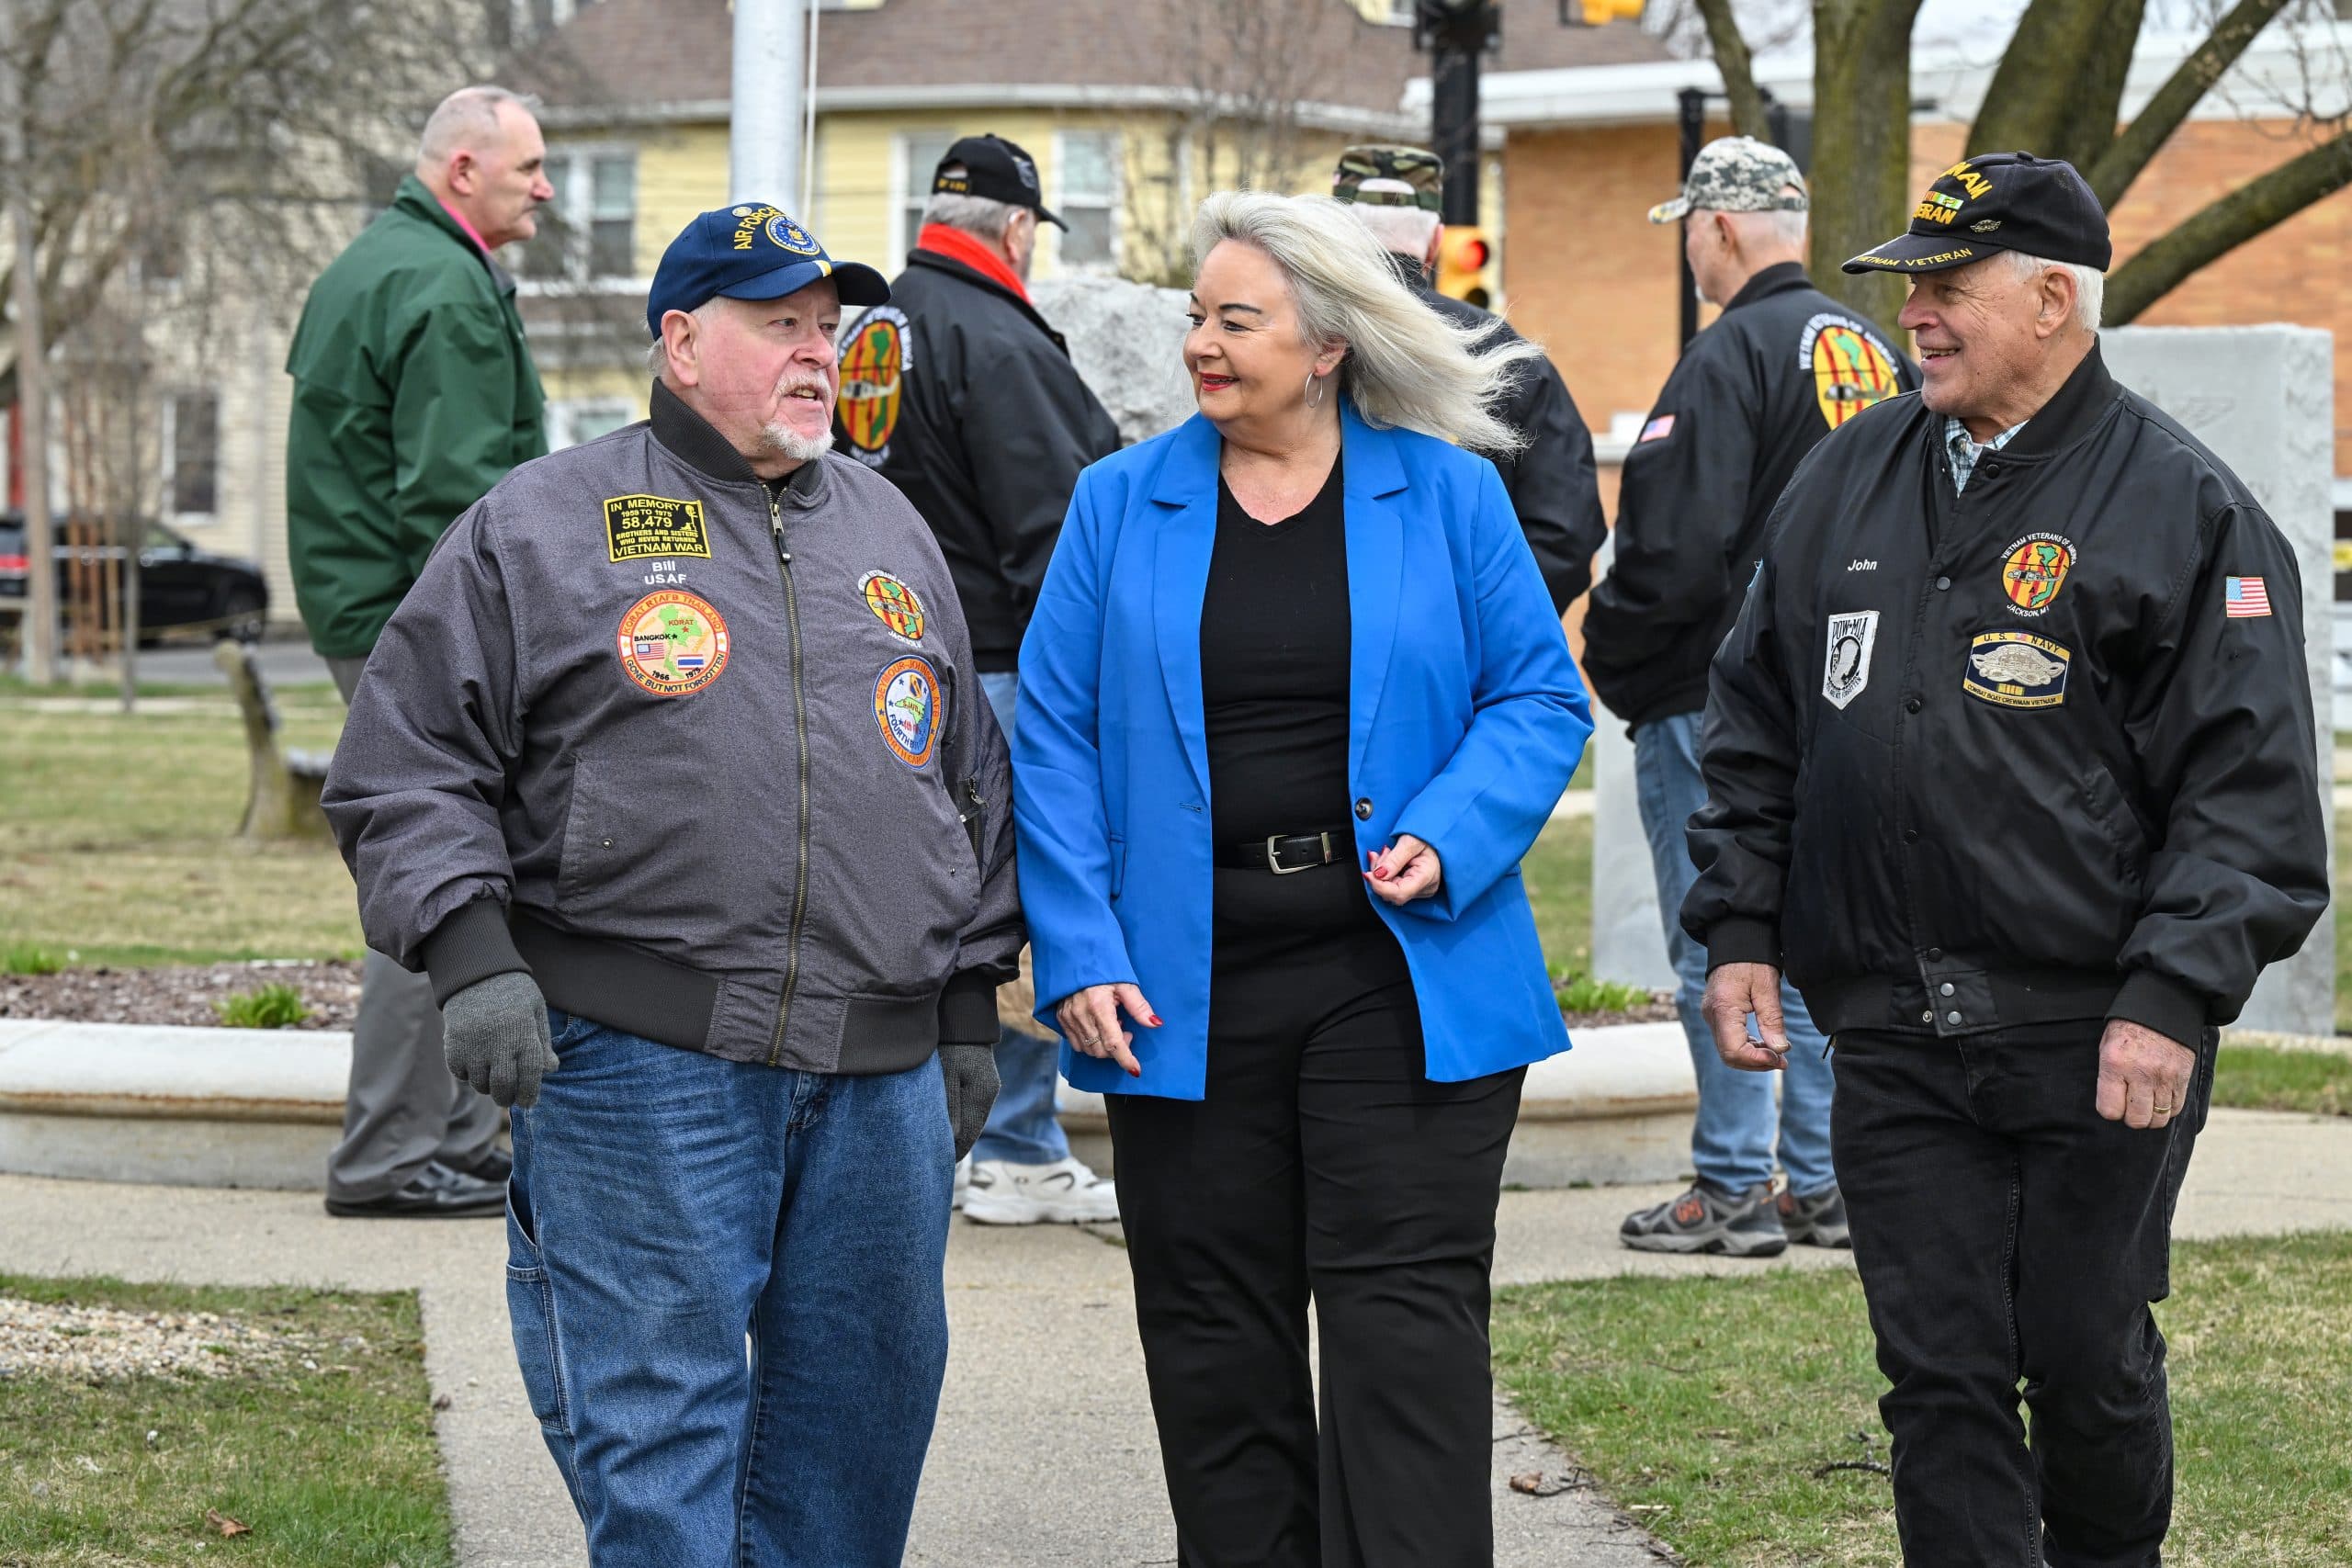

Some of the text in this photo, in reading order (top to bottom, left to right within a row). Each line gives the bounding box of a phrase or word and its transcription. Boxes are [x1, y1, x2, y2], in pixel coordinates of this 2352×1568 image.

[734, 207, 786, 250] AIR FORCE
[1905, 247, 1973, 266] VETERAN
[610, 499, 681, 513] IN MEMORY
[622, 516, 673, 529] 58,479
[616, 529, 652, 540] BROTHERS
[671, 530, 698, 538] SISTERS
[615, 543, 705, 557] VIETNAM WAR
[2000, 536, 2027, 559] VIETNAM
[2027, 532, 2062, 543] VETERANS
[652, 560, 676, 571] Bill
[1847, 558, 1878, 571] John
[645, 574, 687, 585] USAF
[623, 607, 645, 634] KORAT
[646, 593, 679, 607] RTAFB
[683, 594, 721, 630] THAILAND
[634, 633, 672, 642] BANGKOK
[2030, 636, 2061, 653] NAVY
[627, 653, 725, 693] GONE BUT NOT FORGOTTEN
[651, 670, 670, 681] 1966
[1967, 683, 2056, 706] COMBAT BOAT CREWMAN VIETNAM
[889, 714, 910, 747] FOURTH
